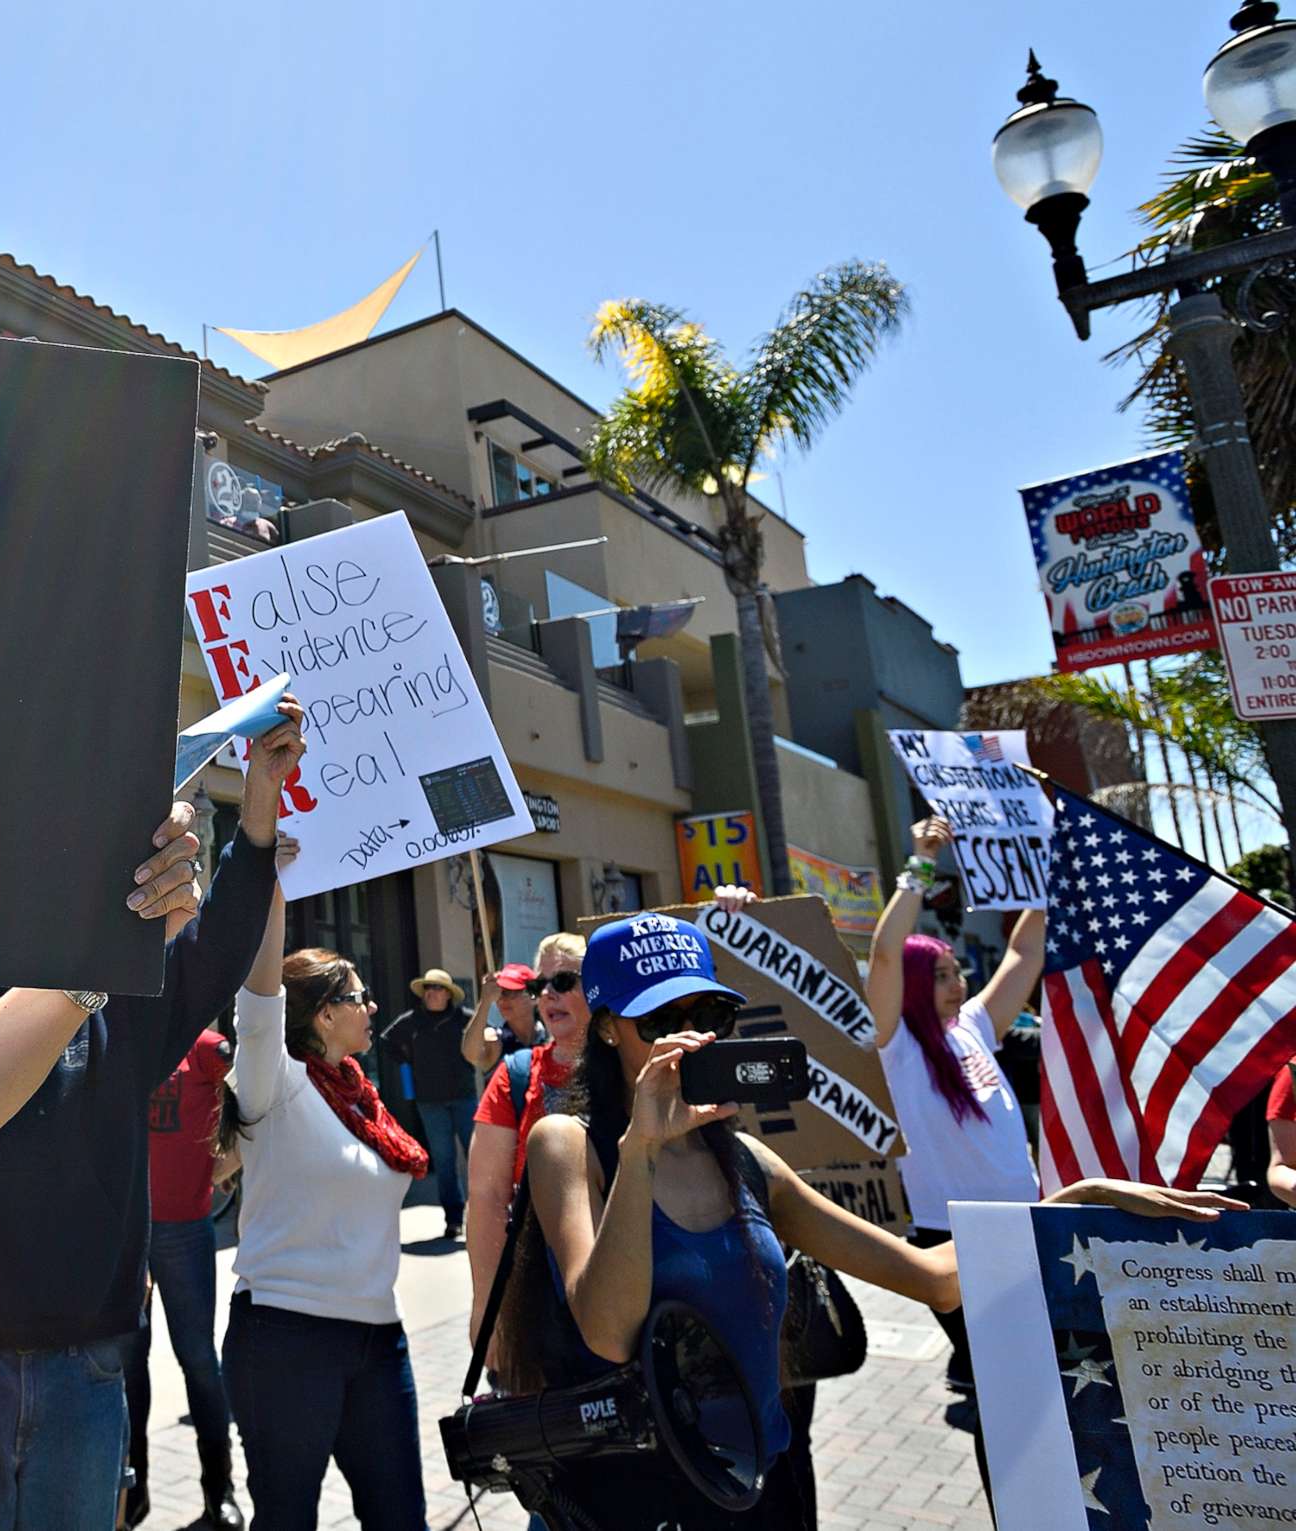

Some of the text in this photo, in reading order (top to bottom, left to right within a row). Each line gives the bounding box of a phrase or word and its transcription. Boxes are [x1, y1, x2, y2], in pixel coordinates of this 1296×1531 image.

[1054, 493, 1161, 535] WORLD
[1046, 531, 1190, 594] Huntington
[1085, 561, 1170, 613] Beach
[1218, 596, 1249, 620] NO
[1066, 629, 1210, 664] HBDOWNTOWN.COM
[1255, 644, 1290, 659] 2:00
[1262, 674, 1296, 690] 11:00
[1246, 692, 1296, 709] ENTIRE
[897, 733, 930, 758] MY
[935, 798, 998, 830] RIGHTS
[1000, 798, 1037, 827] ARE
[339, 825, 394, 870] Data
[693, 862, 752, 891] ALL
[955, 835, 1049, 905] ESSENT
[629, 917, 679, 937] KEEP
[619, 934, 703, 962] AMERICA
[636, 952, 701, 975] GREAT
[705, 907, 873, 1041] QUARANTINE
[806, 1066, 895, 1150] RANNY
[1121, 1259, 1213, 1287] Congress
[1223, 1263, 1266, 1283] shall
[1128, 1294, 1296, 1316] an establishment
[1134, 1325, 1288, 1356] prohibiting the
[1141, 1361, 1162, 1377] or
[1173, 1357, 1273, 1390] abridging
[579, 1398, 616, 1423] PYLE
[1148, 1394, 1168, 1410] or
[1180, 1391, 1203, 1412] of
[1211, 1394, 1245, 1414] the
[1153, 1426, 1296, 1456] people peacea
[1162, 1461, 1287, 1487] petition the
[1170, 1494, 1193, 1515] of
